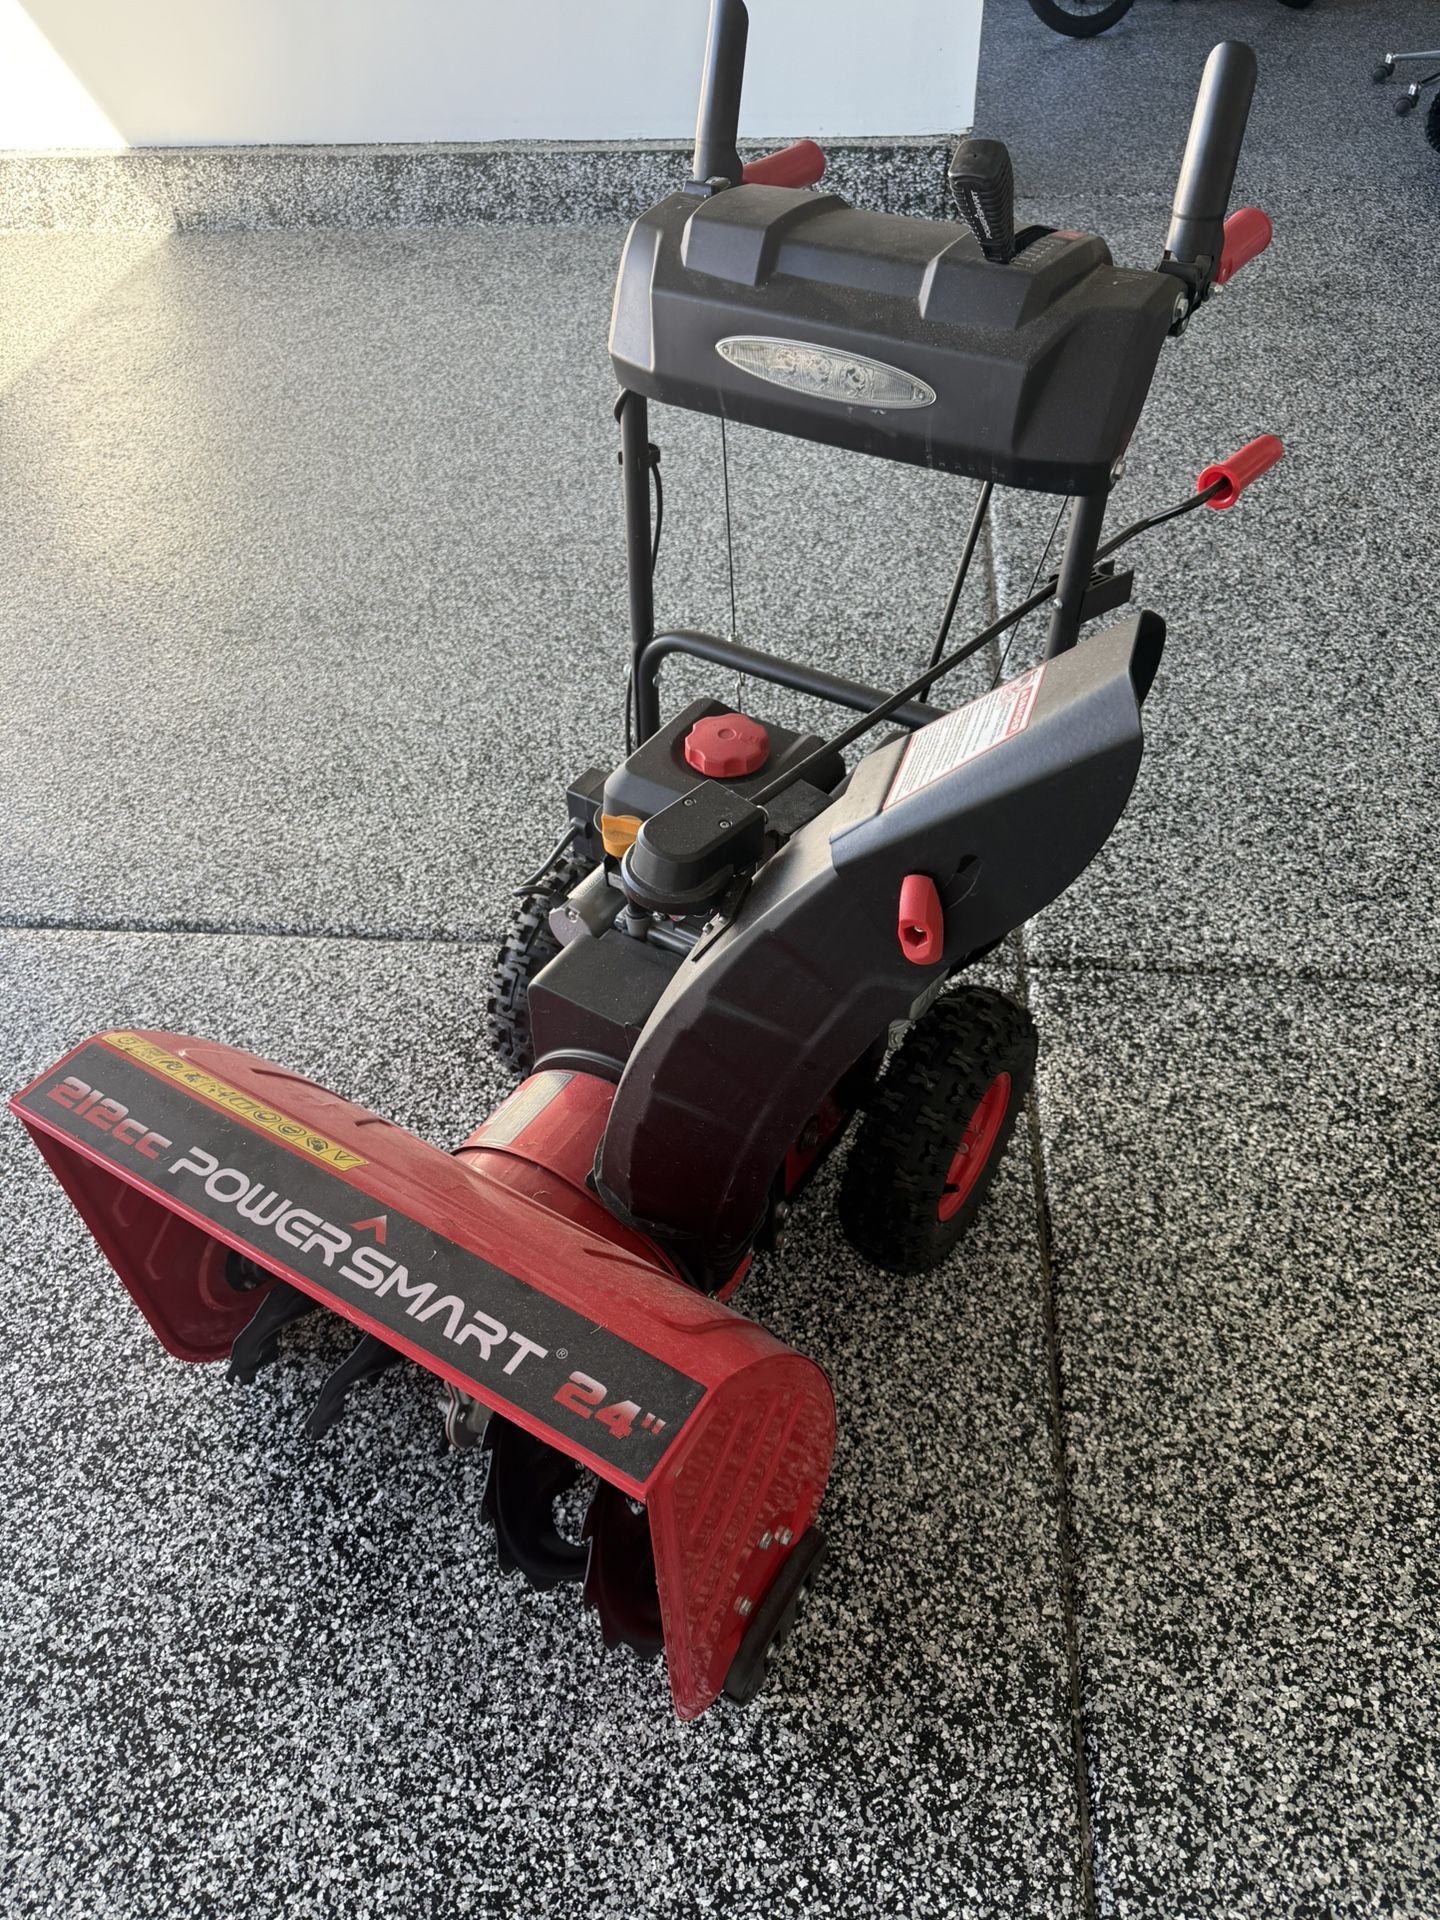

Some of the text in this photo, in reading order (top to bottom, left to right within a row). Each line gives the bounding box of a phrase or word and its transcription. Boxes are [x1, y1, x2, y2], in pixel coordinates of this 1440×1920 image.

[46, 1076, 667, 1441] 212cc POWERSMART 24"
